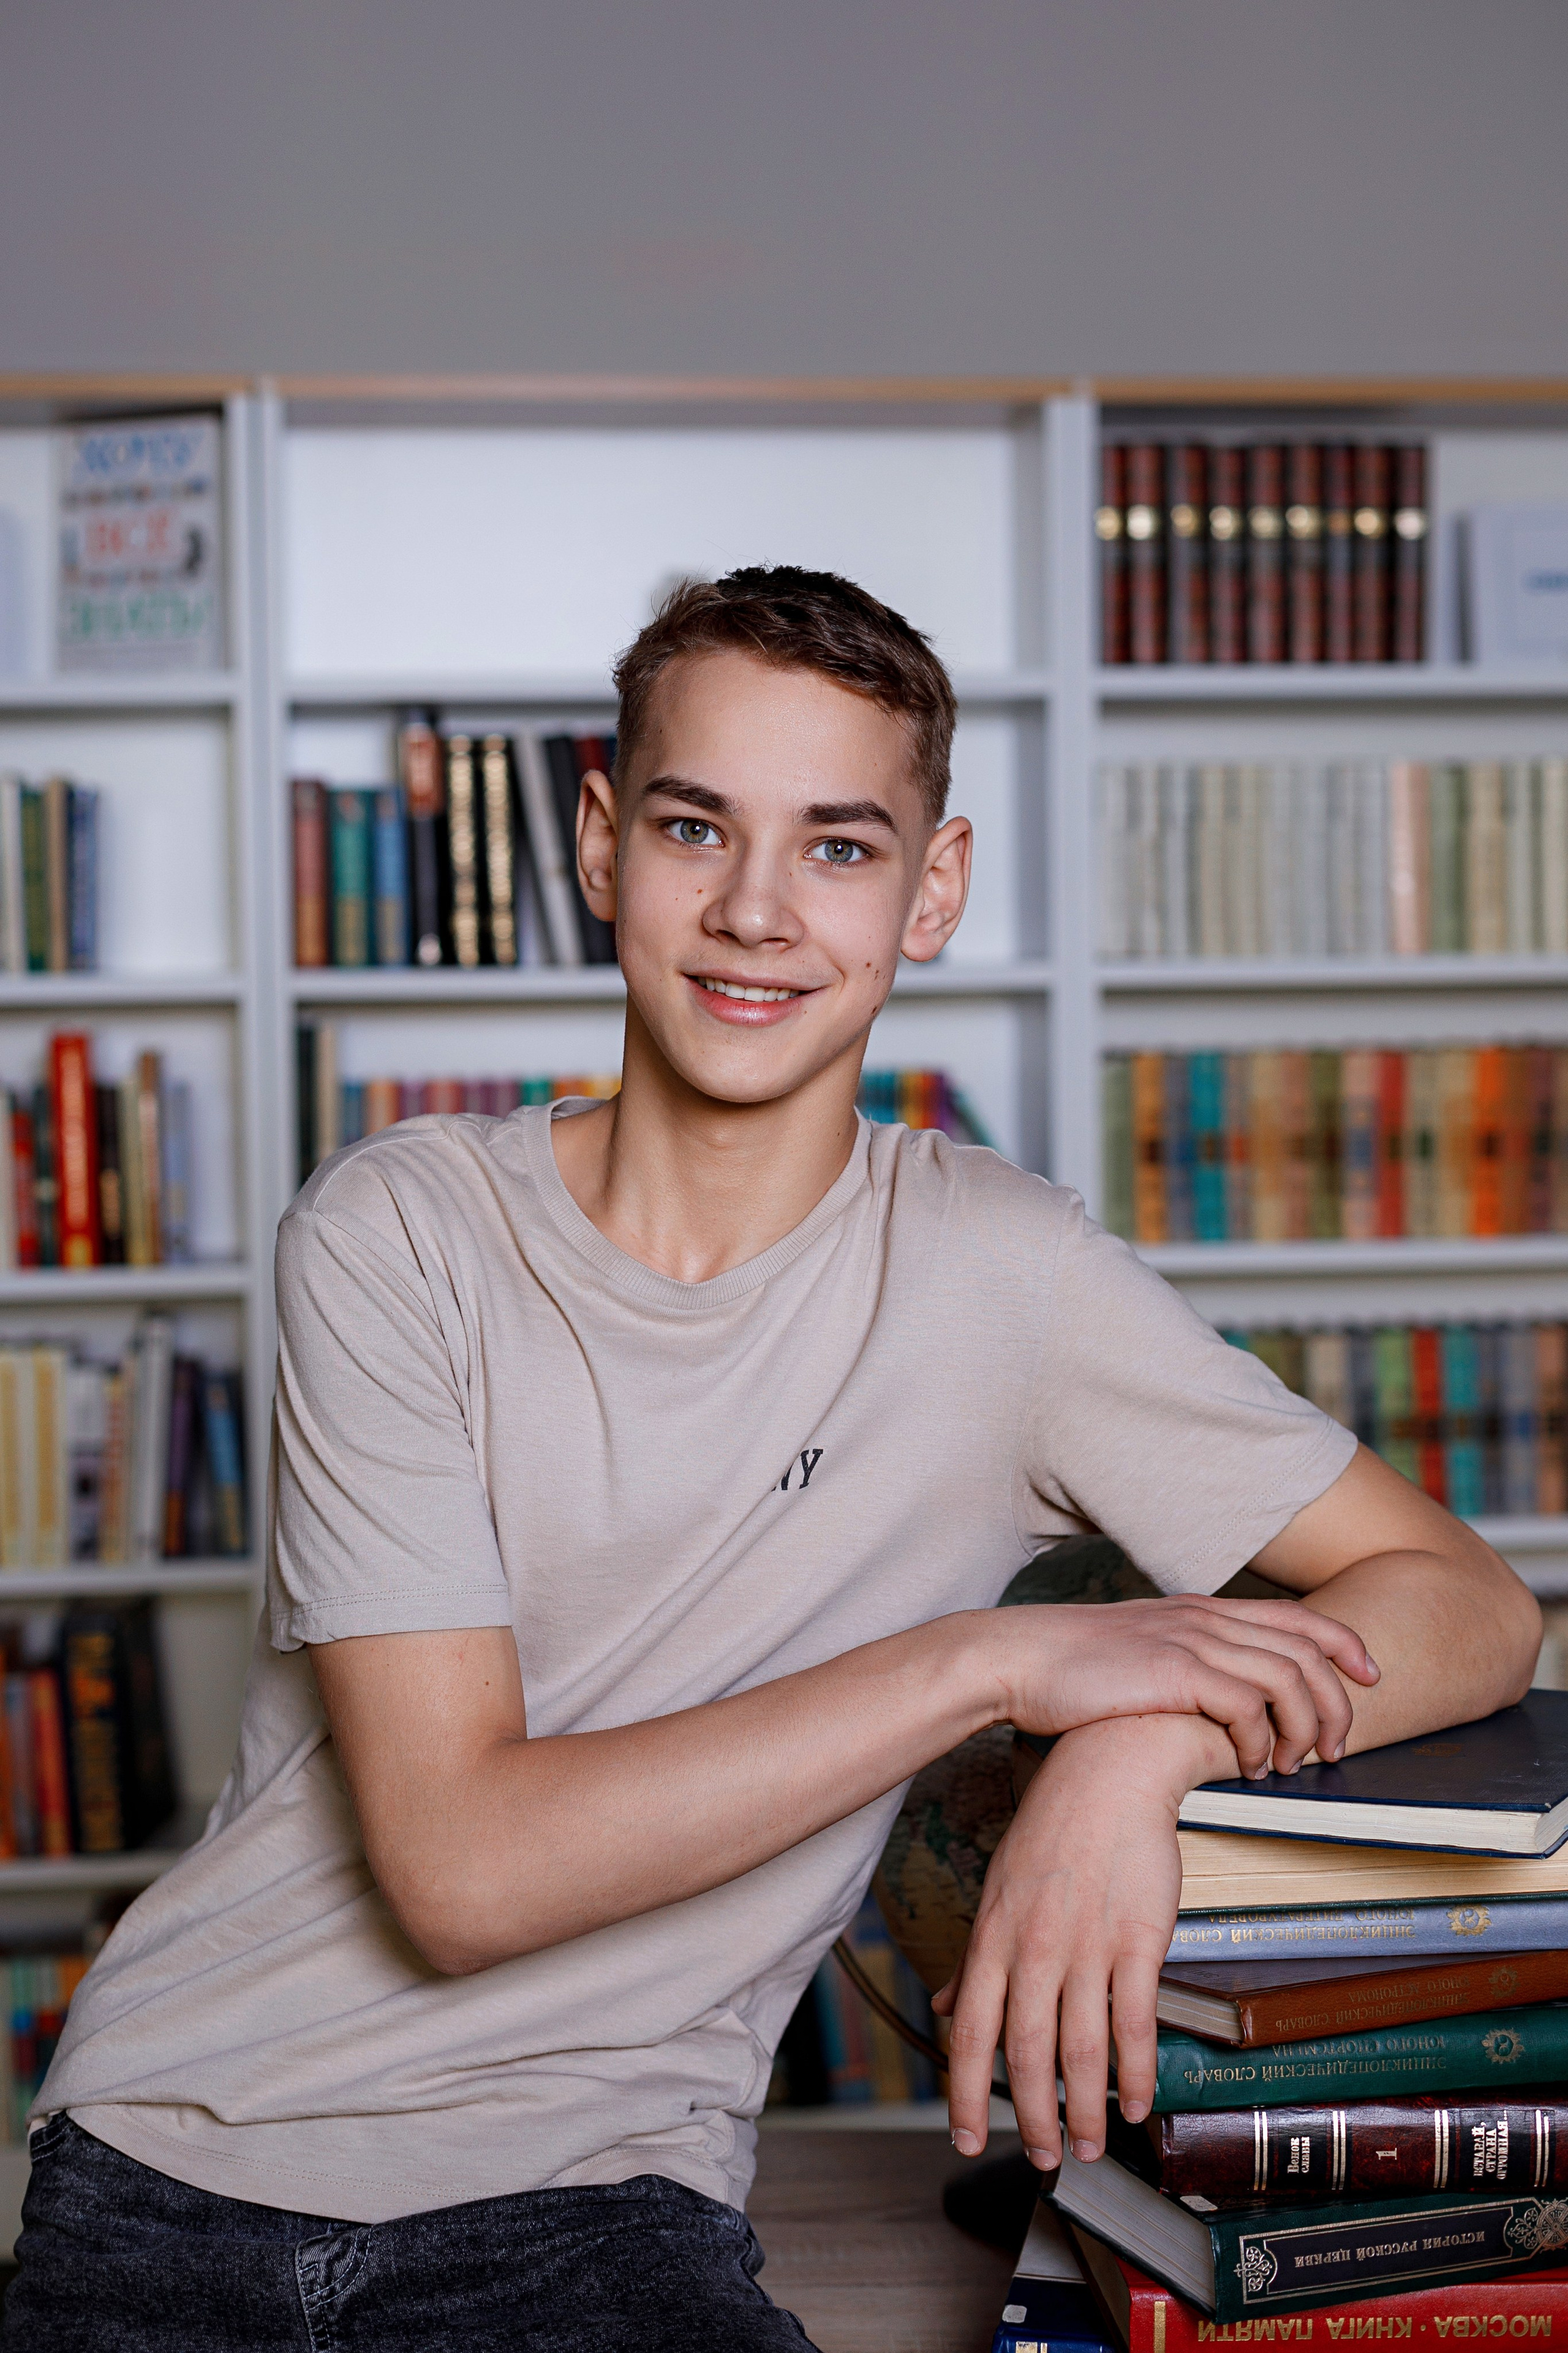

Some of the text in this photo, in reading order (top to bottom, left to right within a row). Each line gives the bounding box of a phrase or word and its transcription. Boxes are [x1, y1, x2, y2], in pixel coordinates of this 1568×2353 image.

[1172, 1924, 1415, 1944] ЭНЦИКЛОПЕДИЧЕСКИЙ СЛОВА
[1348, 1975, 1470, 2003] ЮНОГО АСТРОНОМА
[1275, 1992, 1470, 2031] ЭНЦИКЛОПЕДИЧЕСКИЙ СЛОВАРЬ
[1386, 2036, 1445, 2051] ЮНОГО
[1184, 2057, 1446, 2083] ЭНЦИКЛОПЕДИЧЕСКИЙ СЛОВАРЬ
[1287, 2137, 1300, 2174] Венок
[1301, 2136, 1310, 2174] славы
[1376, 2147, 1397, 2160] 1
[1485, 2128, 1497, 2174] СТРАНА
[1294, 2230, 1486, 2268] ИСТОРИЯ РУССКОЙ ЦЕРКВИ
[1197, 2314, 1553, 2343] МОСКВА КНИГА ПАМЯТИ
